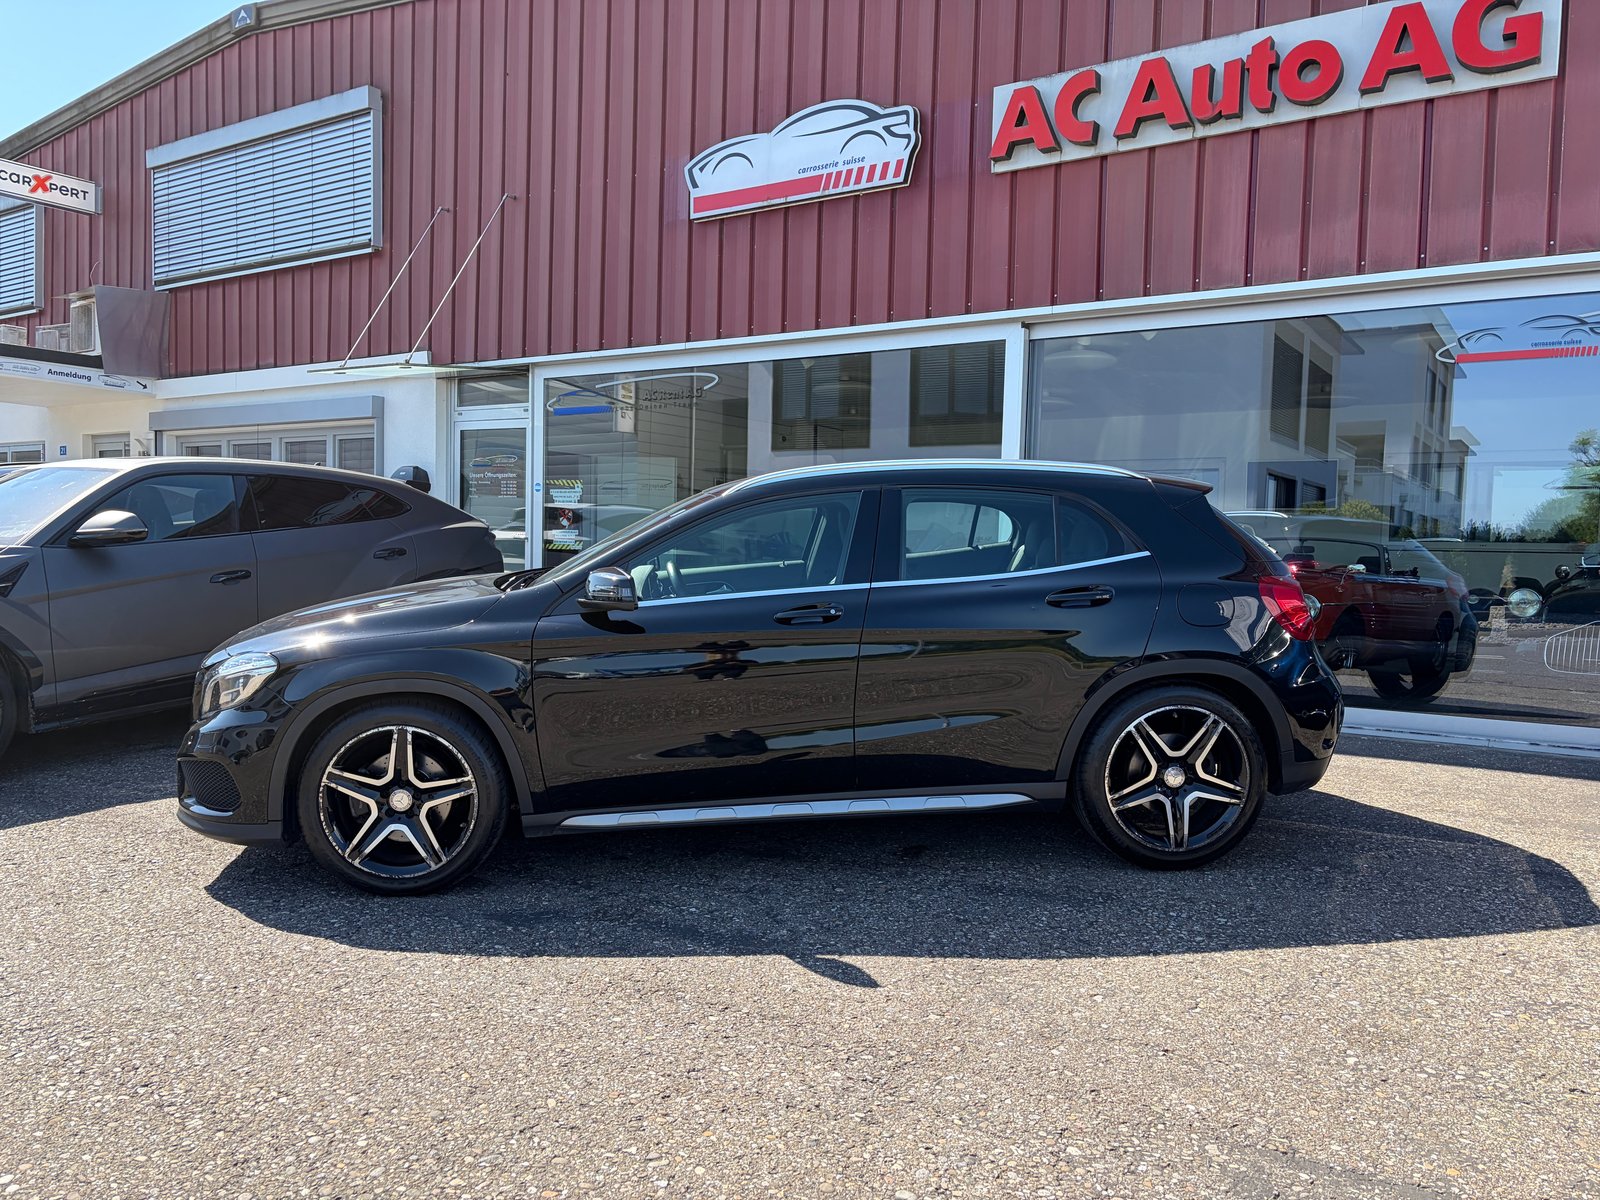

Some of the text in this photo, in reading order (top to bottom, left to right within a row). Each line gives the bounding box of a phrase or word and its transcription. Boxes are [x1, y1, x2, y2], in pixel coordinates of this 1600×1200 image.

[988, 0, 1543, 162] AC Auto AG
[798, 155, 866, 174] carrosserie suisse
[47, 368, 92, 382] Anmeldung
